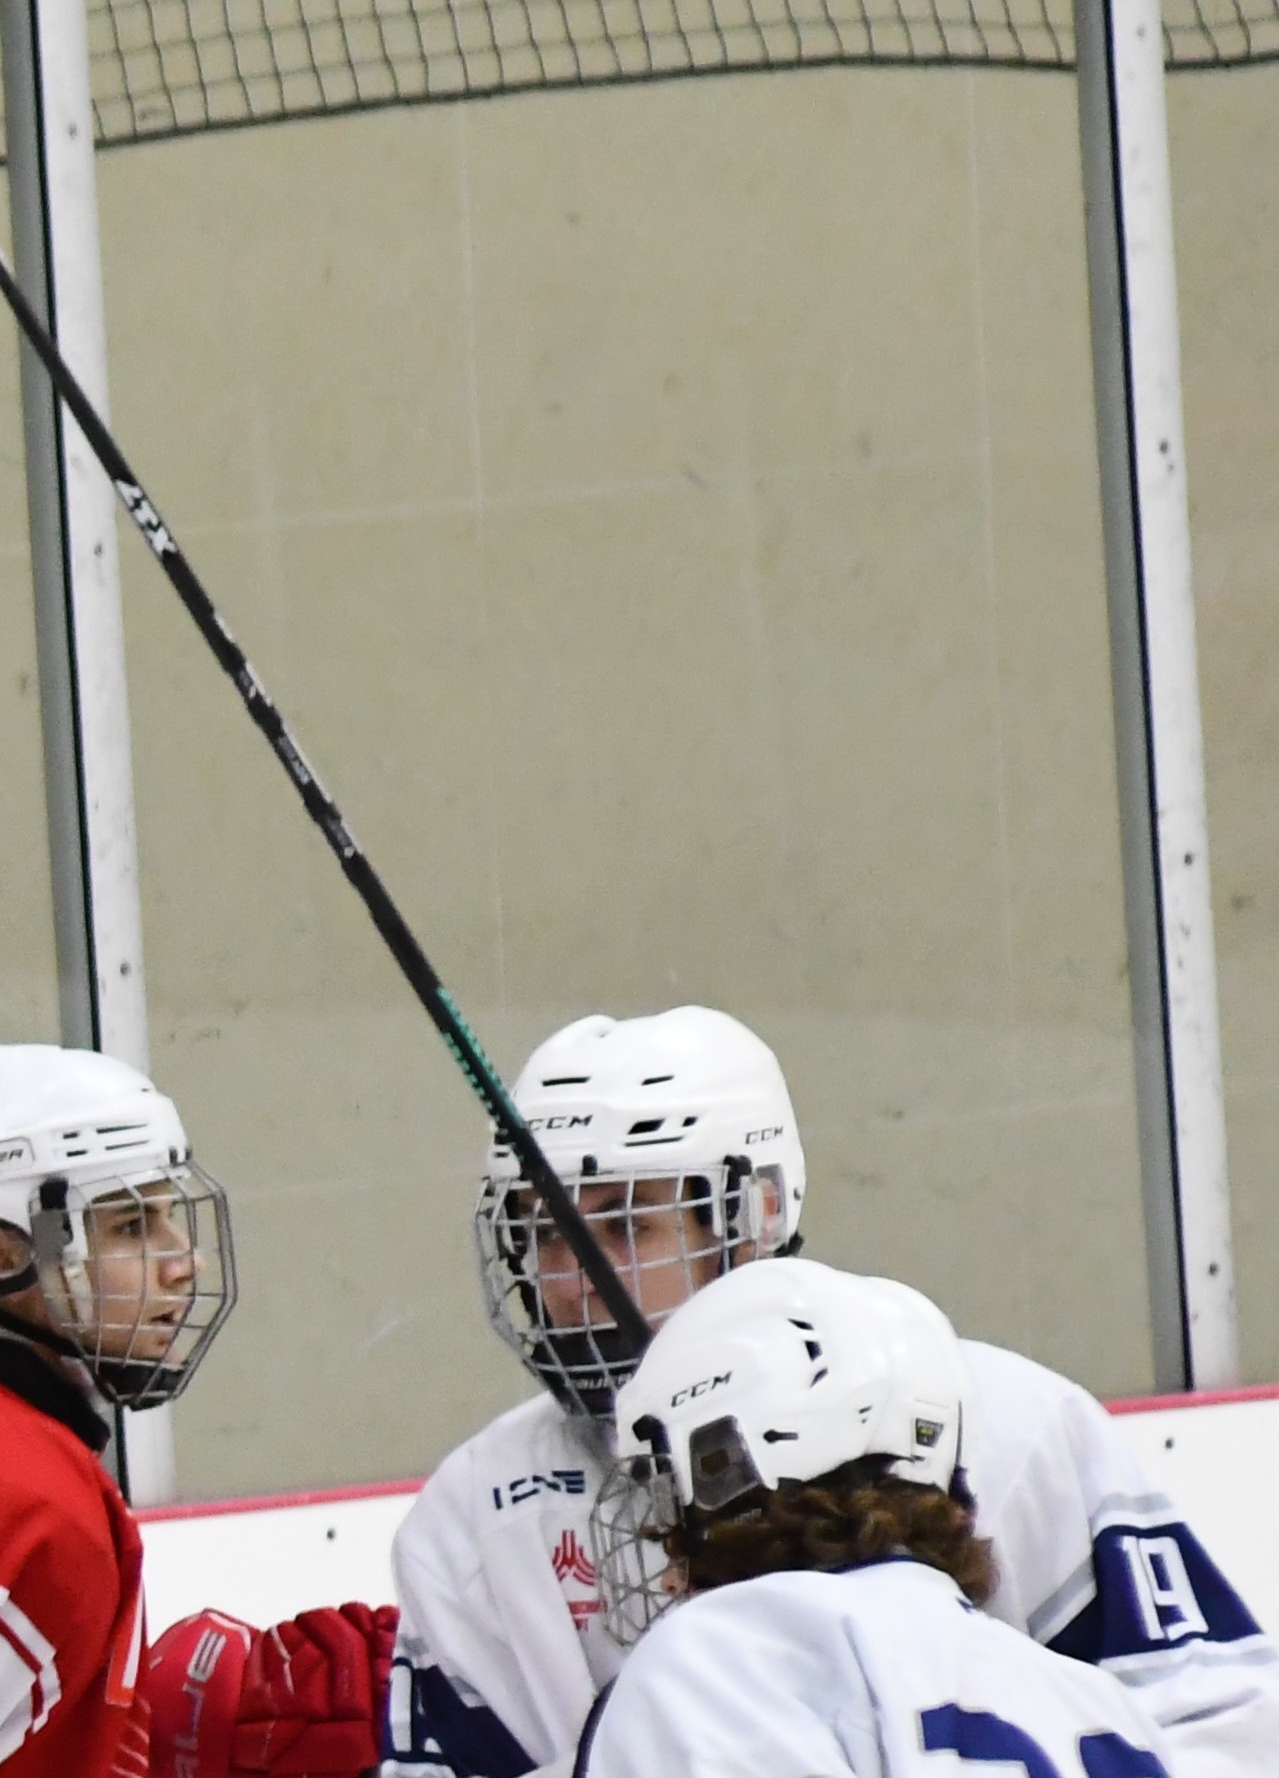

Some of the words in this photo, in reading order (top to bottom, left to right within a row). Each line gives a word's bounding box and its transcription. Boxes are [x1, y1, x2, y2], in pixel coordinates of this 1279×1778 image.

[527, 1115, 593, 1132] CCM
[745, 1126, 784, 1144] CCM
[670, 1370, 733, 1408] CCM
[1118, 1535, 1209, 1641] 19
